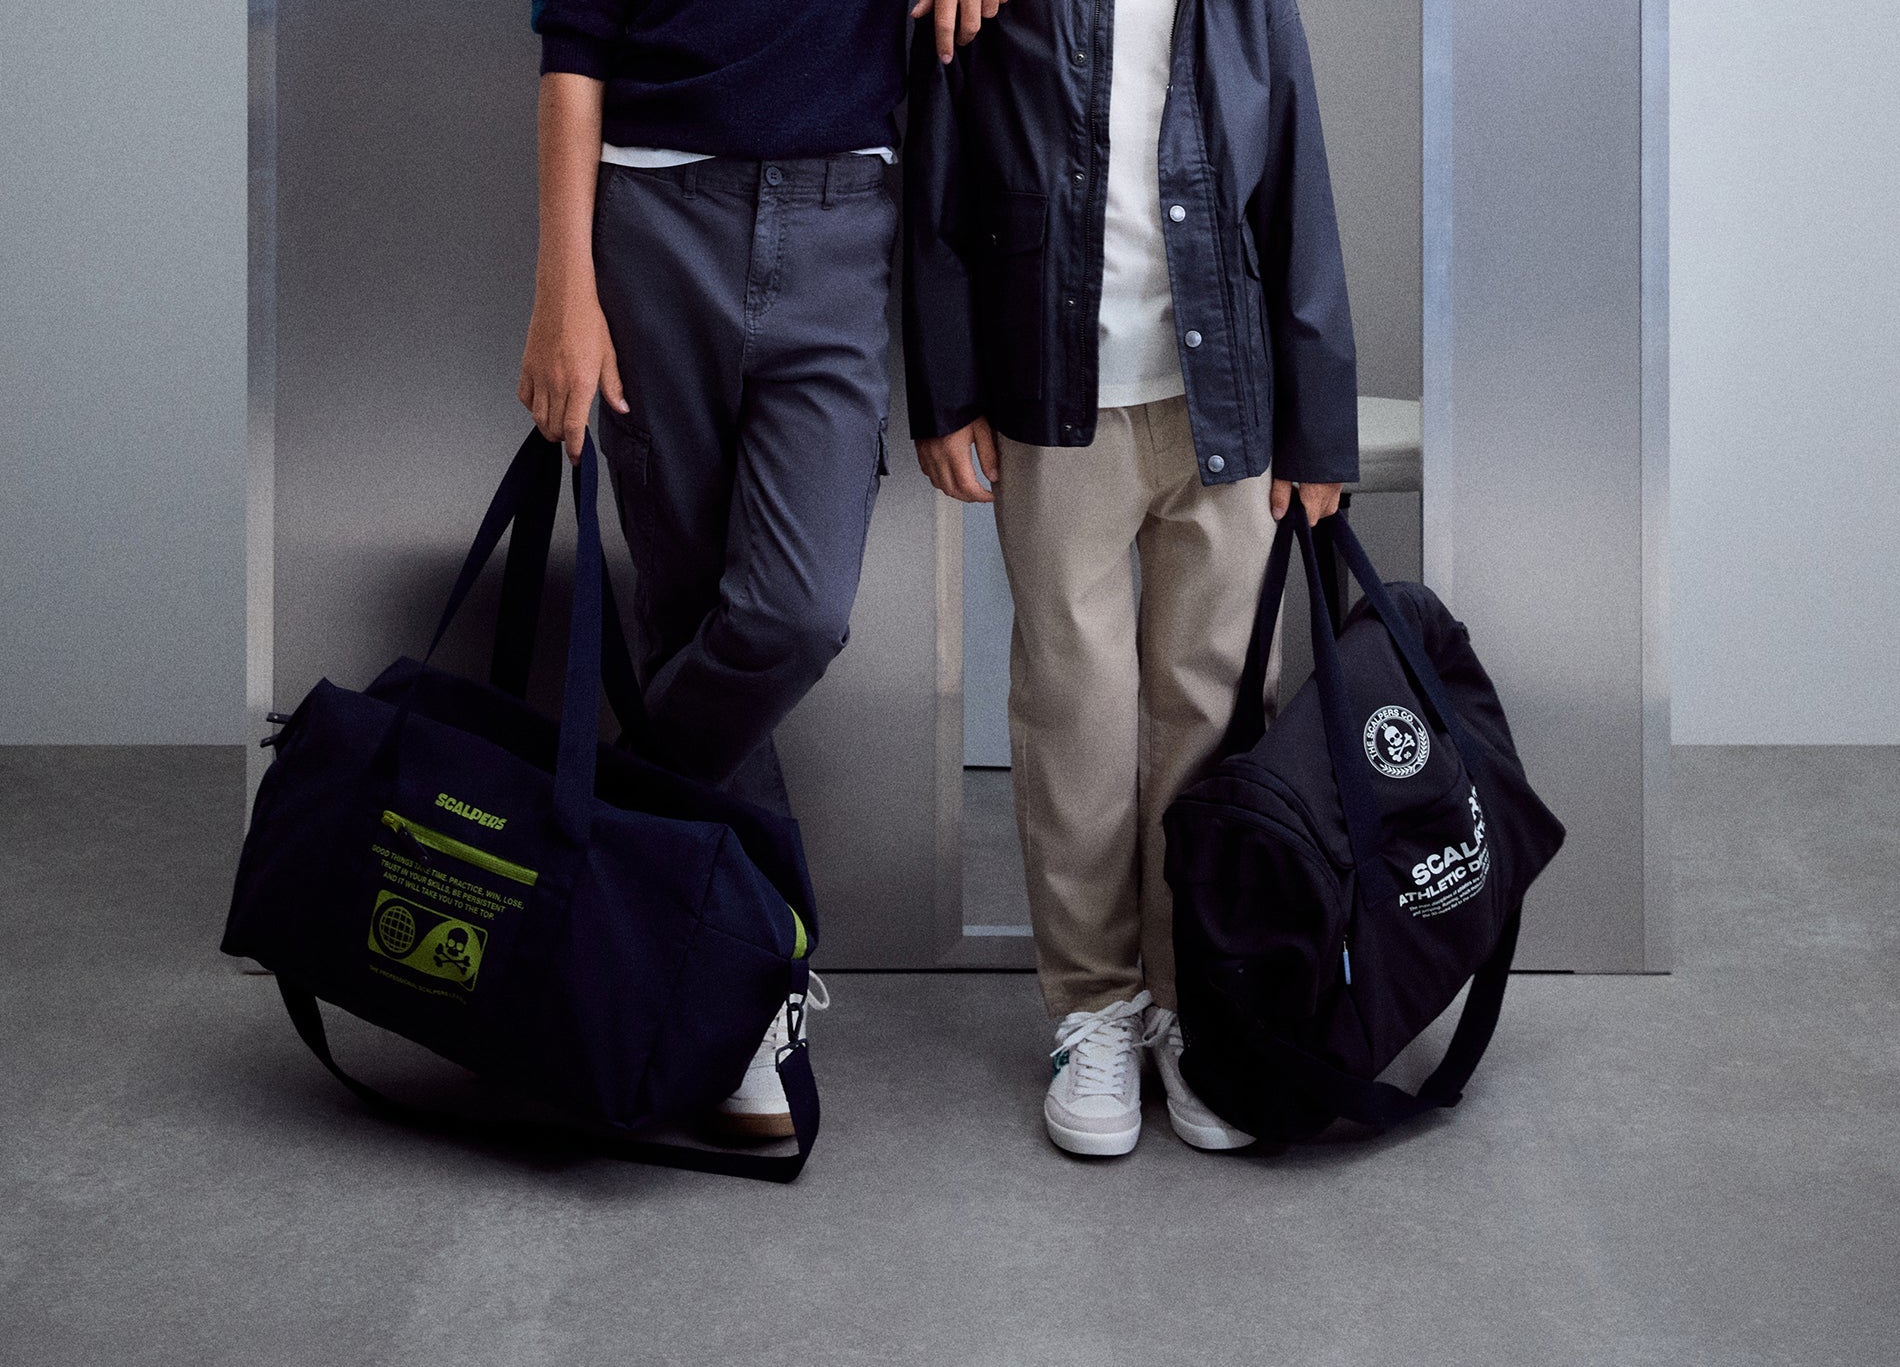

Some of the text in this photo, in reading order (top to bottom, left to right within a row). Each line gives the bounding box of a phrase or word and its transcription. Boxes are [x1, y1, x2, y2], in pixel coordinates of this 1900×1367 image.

[1367, 709, 1399, 739] SCALPERS
[1367, 740, 1378, 760] THE
[434, 792, 508, 831] SCALPERS
[390, 852, 415, 868] THINGS
[380, 859, 402, 874] TRUST
[401, 867, 410, 877] IN
[409, 870, 427, 885] YOUR
[452, 887, 462, 897] BE
[461, 891, 506, 913] PERSISTENT
[382, 871, 397, 883] AND
[397, 876, 404, 885] IT
[404, 879, 421, 893] WILL
[421, 886, 438, 900] TAKE
[438, 893, 453, 905] YOU
[453, 899, 464, 909] TO
[464, 903, 480, 915] THE
[1399, 866, 1467, 907] ATHLETIC
